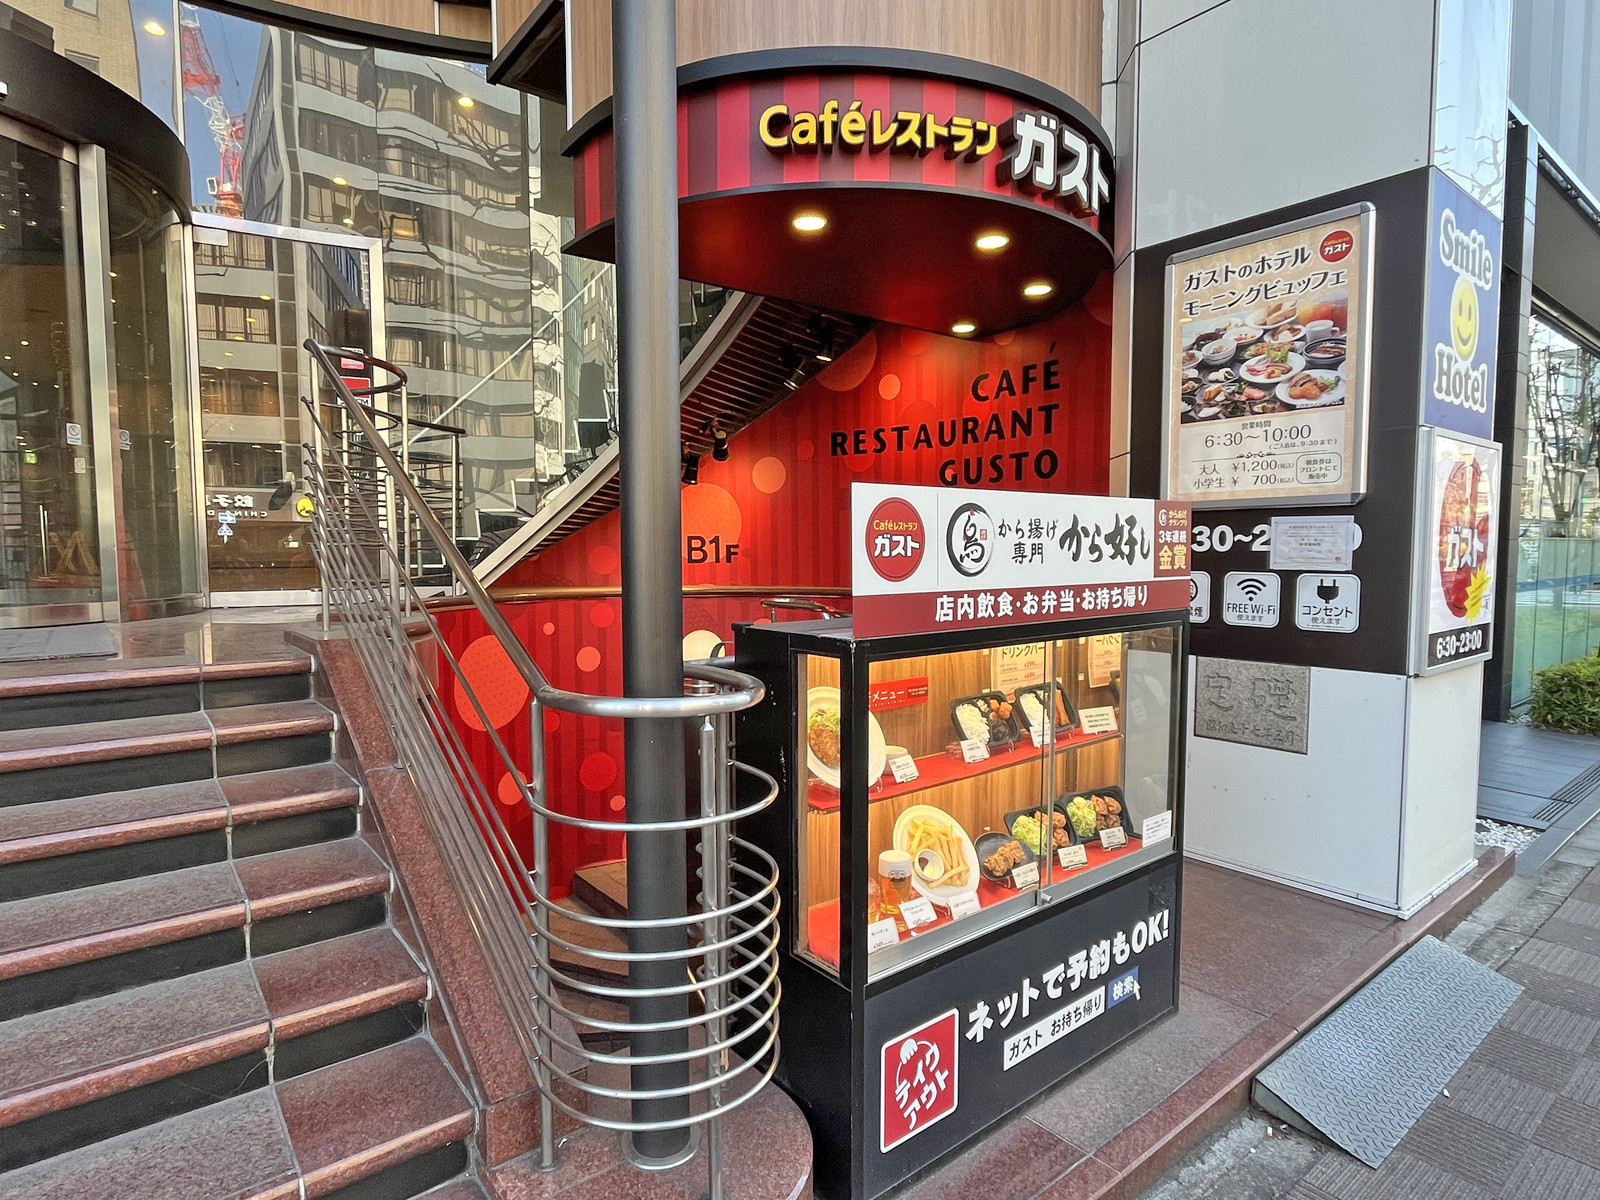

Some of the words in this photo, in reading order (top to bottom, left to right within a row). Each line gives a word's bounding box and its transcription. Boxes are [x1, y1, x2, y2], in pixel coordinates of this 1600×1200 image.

[759, 100, 997, 154] Caféレストラン
[1012, 111, 1110, 212] ガスト
[1324, 243, 1350, 255] ガスト
[1440, 209, 1492, 289] Smile
[1184, 247, 1312, 293] ガストのホテル
[1183, 271, 1347, 316] モーニングビュッフェ
[971, 343, 1060, 402] CAFÉ
[1434, 344, 1486, 412] Hotel
[830, 404, 1060, 456] RESTAURANT
[1241, 420, 1272, 430] 営業時間
[940, 448, 1059, 487] GUSTO
[1199, 463, 1220, 476] 大人
[1193, 477, 1226, 489] 小学生
[998, 518, 1058, 541] から揚げ
[1058, 513, 1151, 566] から好し
[1158, 529, 1187, 543] 3年連続
[686, 535, 740, 564] B1F
[874, 533, 920, 557] ガスト
[1011, 542, 1045, 565] 専門
[1158, 544, 1187, 570] 金賞
[1445, 526, 1484, 571] ガスト
[1226, 603, 1249, 613] FREE
[1250, 603, 1276, 615] Wi-Fi
[1236, 614, 1264, 622] 使えます
[1302, 604, 1354, 618] コンセント
[1311, 616, 1342, 625] 使えます
[1001, 643, 1045, 660] ドリンクバー
[965, 908, 1170, 1044] ネットで予約もOK!
[1008, 1029, 1044, 1062] ガスト
[1049, 993, 1103, 1037] お持ち帰り
[1112, 976, 1135, 1002] 検索
